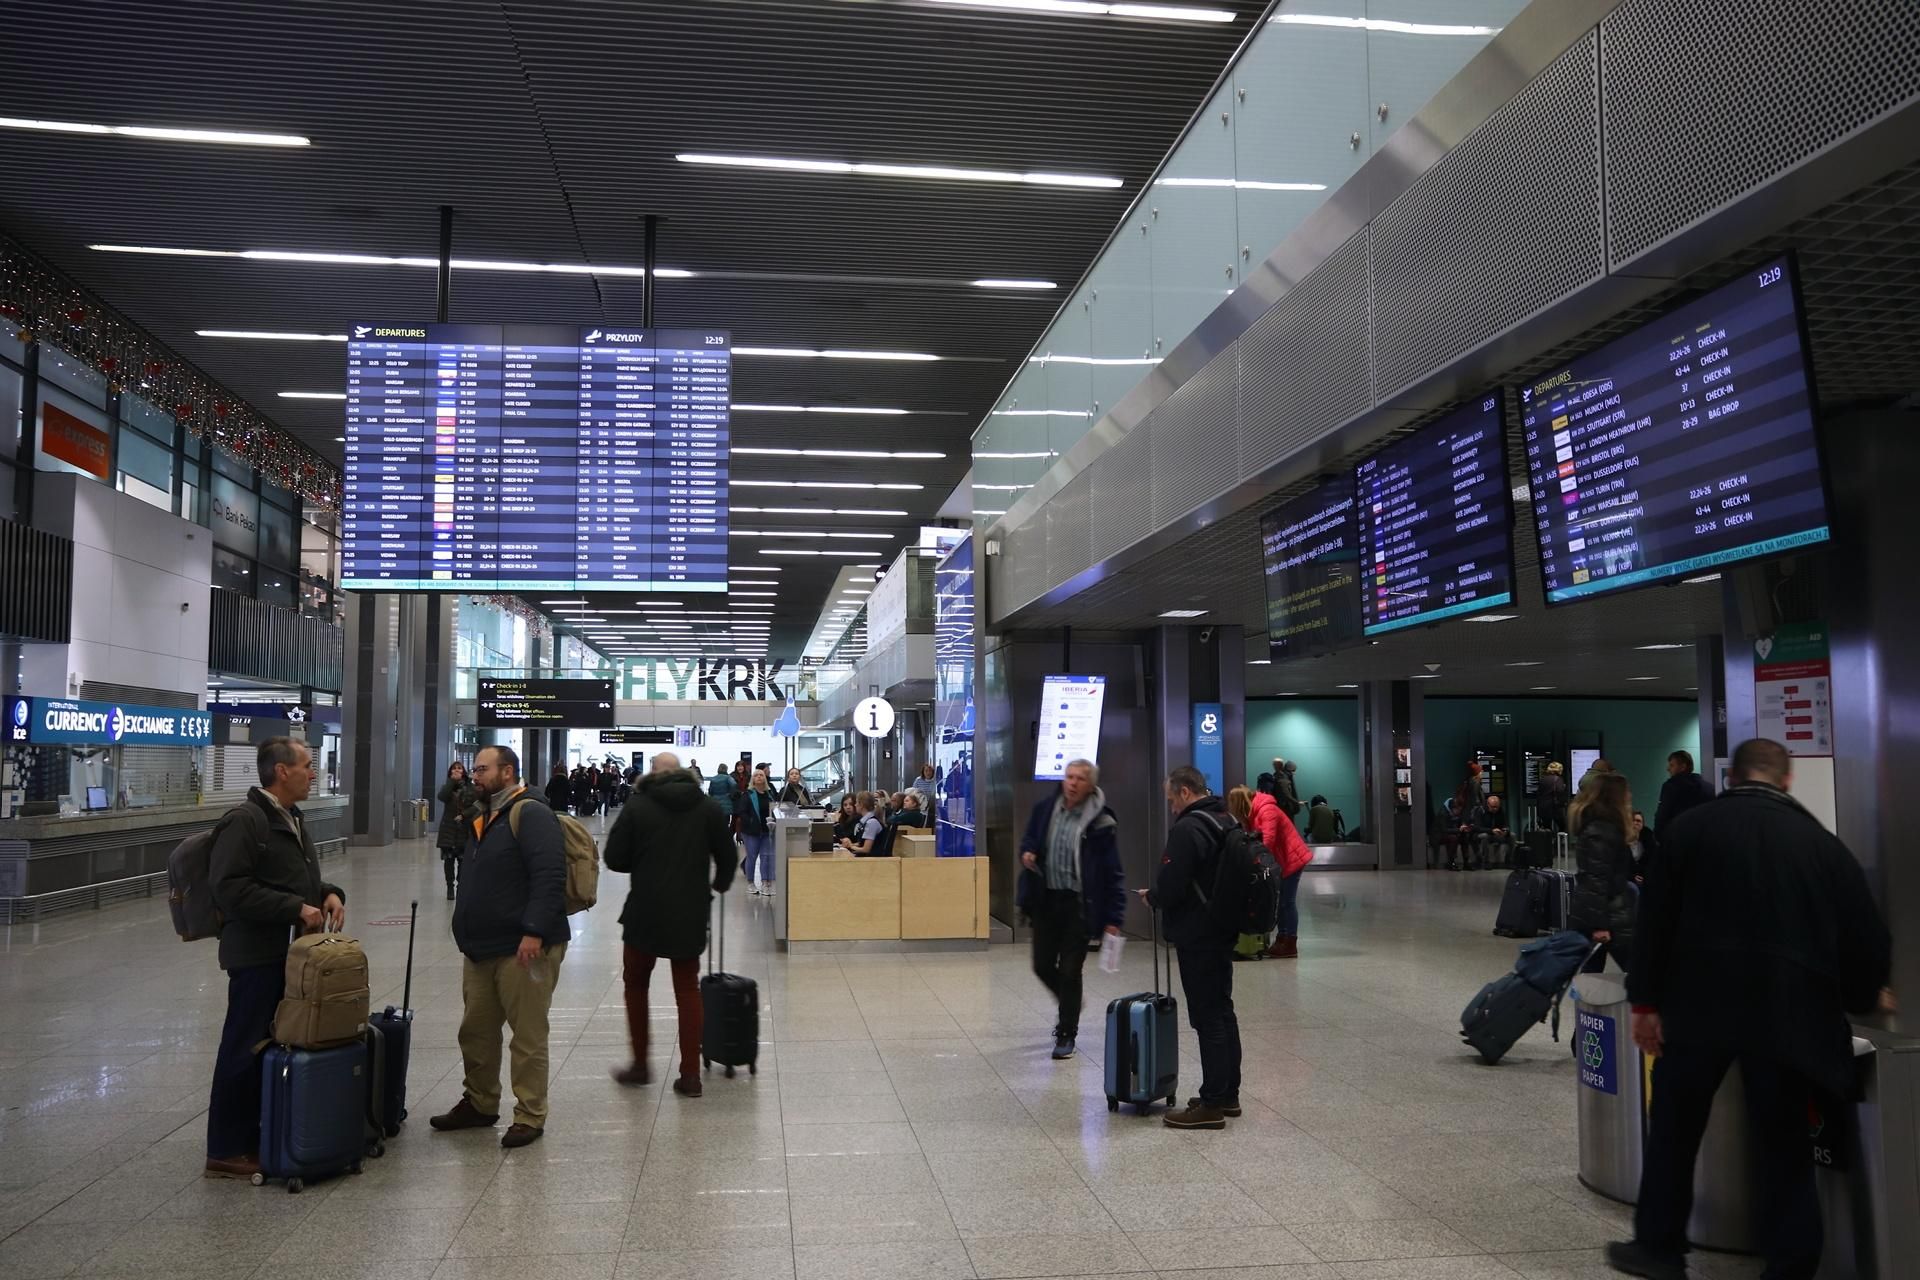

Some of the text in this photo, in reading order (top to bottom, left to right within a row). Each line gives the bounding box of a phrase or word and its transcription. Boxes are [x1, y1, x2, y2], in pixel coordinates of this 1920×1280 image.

[1758, 266, 1780, 288] 12:19
[375, 329, 426, 337] DEPARTURES
[606, 334, 643, 342] PRZYLOTY
[1698, 329, 1726, 348] CHECK-IN
[1670, 345, 1690, 361] 22,24-26
[1700, 347, 1728, 366] CHECK-IN
[1675, 364, 1690, 377] 43-44
[1703, 365, 1731, 384] CHECK-IN
[1534, 370, 1572, 395] DEPARTURES
[1583, 380, 1734, 401] ODESA (ODS) 37 CHECK-IN
[1584, 394, 1695, 416] MUNICH (MUC) 10-13
[1587, 401, 1739, 432] STUTTGART (STR) 28-29 BAG DROP
[65, 424, 105, 456] express
[1589, 434, 1607, 448] LONDYN
[1609, 424, 1635, 442] HEATHROW
[1637, 416, 1651, 431] (LHR)
[1591, 450, 1609, 464] BRISTOL
[1610, 444, 1624, 457] (BRS)
[1594, 461, 1622, 479] DUSSELDORF
[1624, 456, 1639, 470] (DUS)
[1535, 474, 1748, 500] 14:20 TURIN (TRN) 22,24-26 CHECK-IN
[1598, 498, 1618, 511] WARSAW
[1696, 505, 1711, 516] 43-44
[1722, 493, 1750, 509] CHECK-IN
[226, 505, 256, 532] Bank Pekao
[1538, 512, 1753, 534] 15:05 22,24-26 CHECK-IN
[1650, 566, 1672, 577] NUMERY
[1765, 542, 1775, 551] NA
[1776, 533, 1822, 549] MONITORACH
[46, 710, 108, 732] CURRENCY
[124, 717, 174, 734] EXCHANGE
[870, 704, 879, 730] i
[13, 726, 26, 740] ice
[1581, 1014, 1604, 1031] PAPIER
[1583, 1070, 1604, 1088] PAPER
